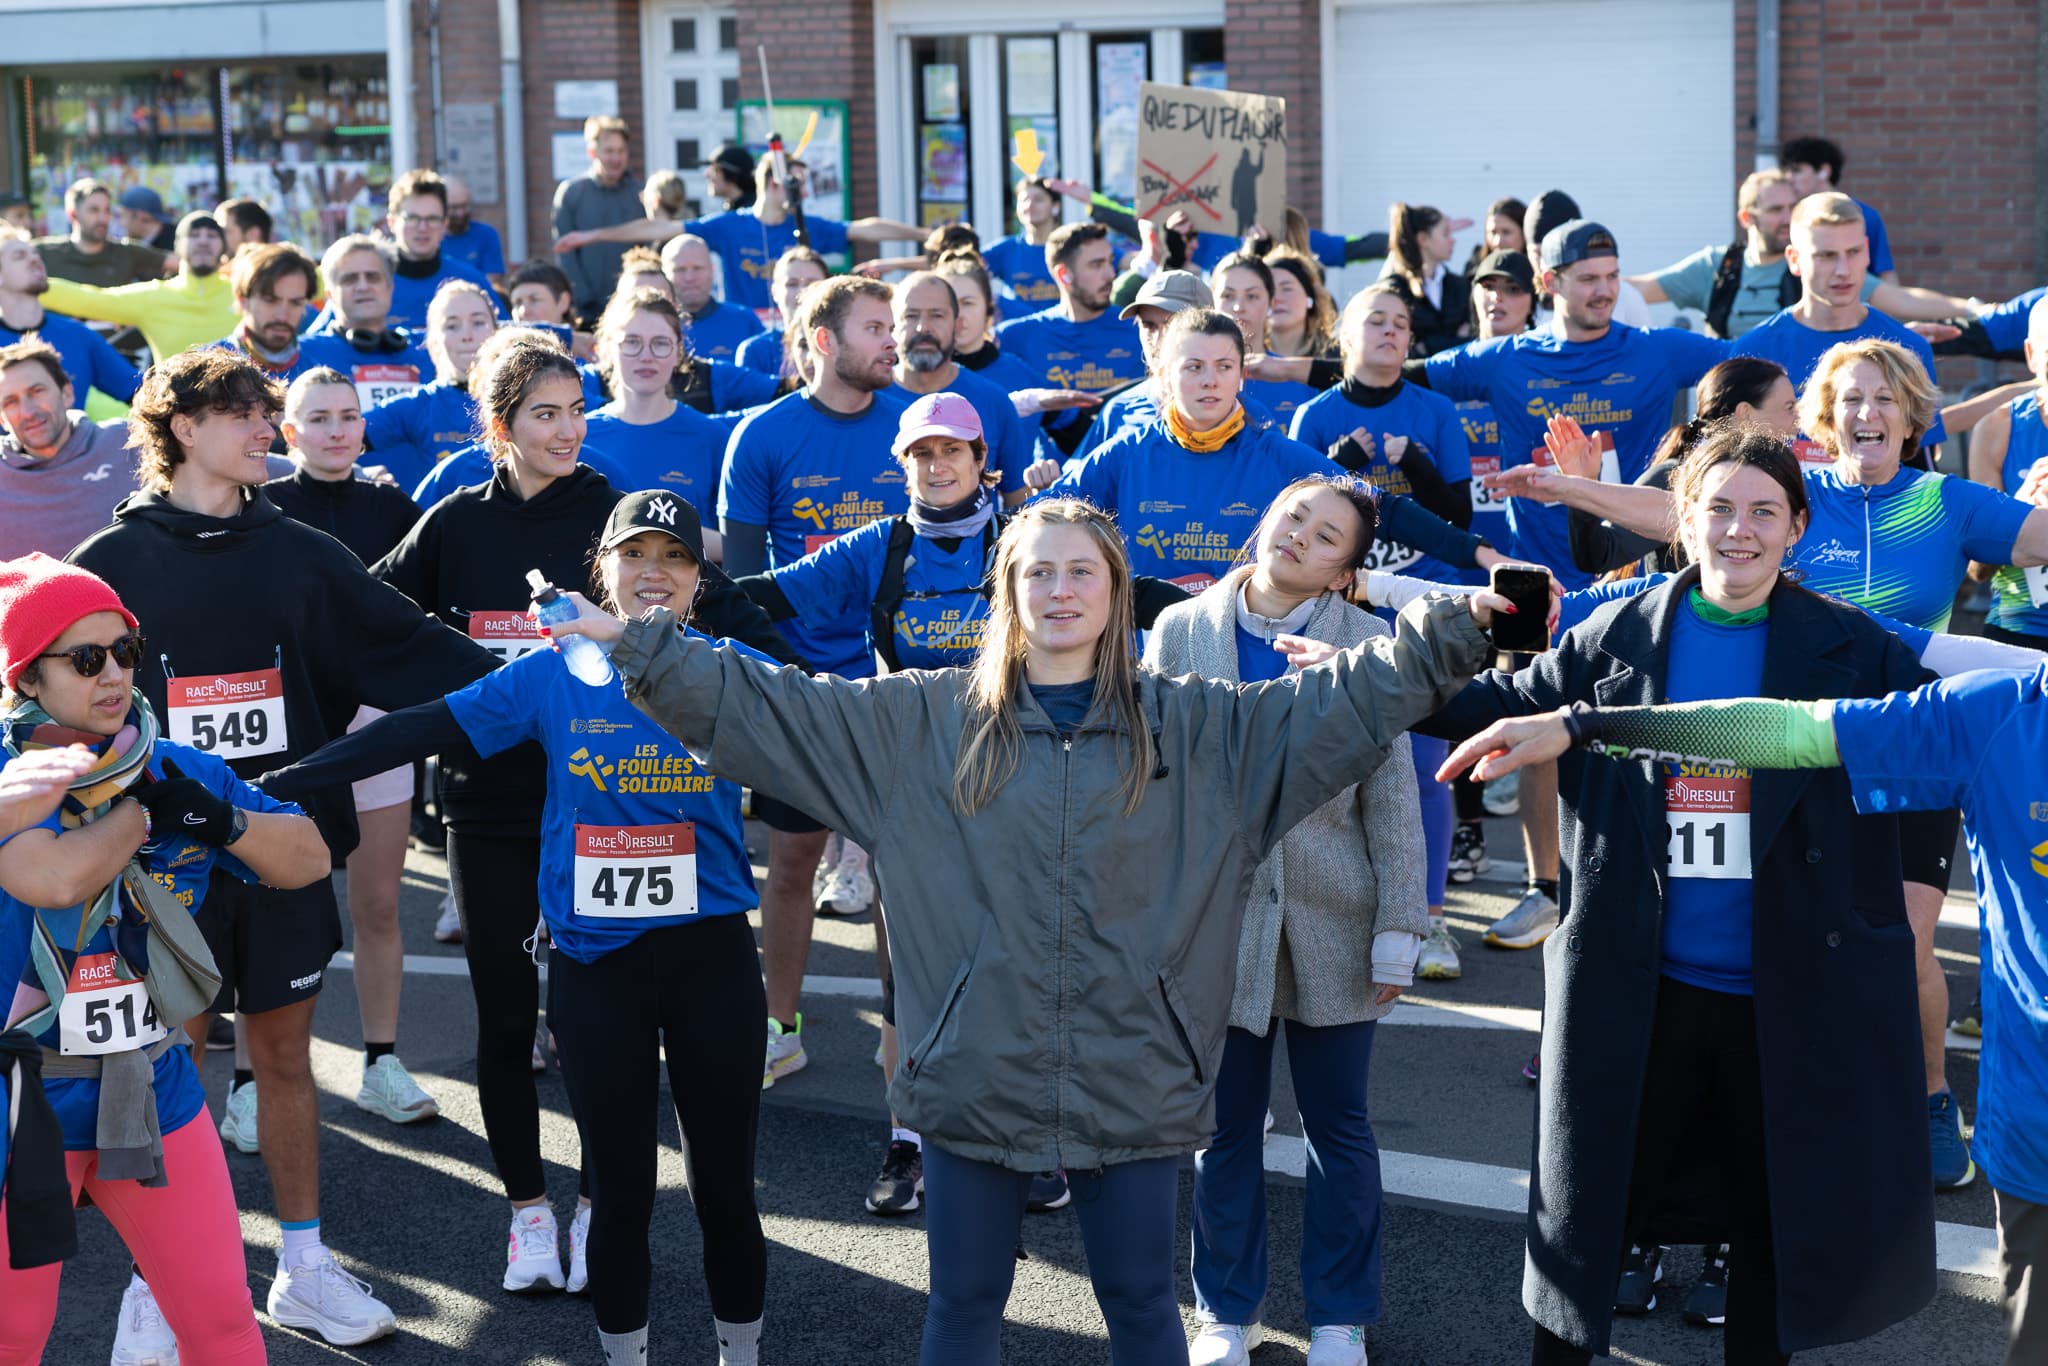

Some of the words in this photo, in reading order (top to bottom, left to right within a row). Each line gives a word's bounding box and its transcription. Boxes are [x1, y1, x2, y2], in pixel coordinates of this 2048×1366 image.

[1144, 95, 1179, 131] QUE
[1182, 103, 1216, 140] DU
[1572, 392, 1588, 402] LES
[1562, 398, 1611, 414] FOULÉES
[843, 491, 859, 502] LES
[832, 499, 884, 516] FOULÉES
[1185, 521, 1204, 532] LES
[1172, 531, 1229, 547] FOULÉES
[941, 609, 961, 621] LES
[485, 620, 511, 631] RACE
[186, 686, 215, 698] RACE
[229, 680, 267, 694] RESULT
[191, 708, 268, 751] 549
[634, 744, 659, 757] LES
[617, 754, 694, 776] FOULÉES
[1690, 789, 1735, 802] RESULT
[588, 837, 616, 849] RACE
[632, 835, 675, 848] RESULT
[592, 866, 674, 907] 475
[80, 965, 112, 980] RACE
